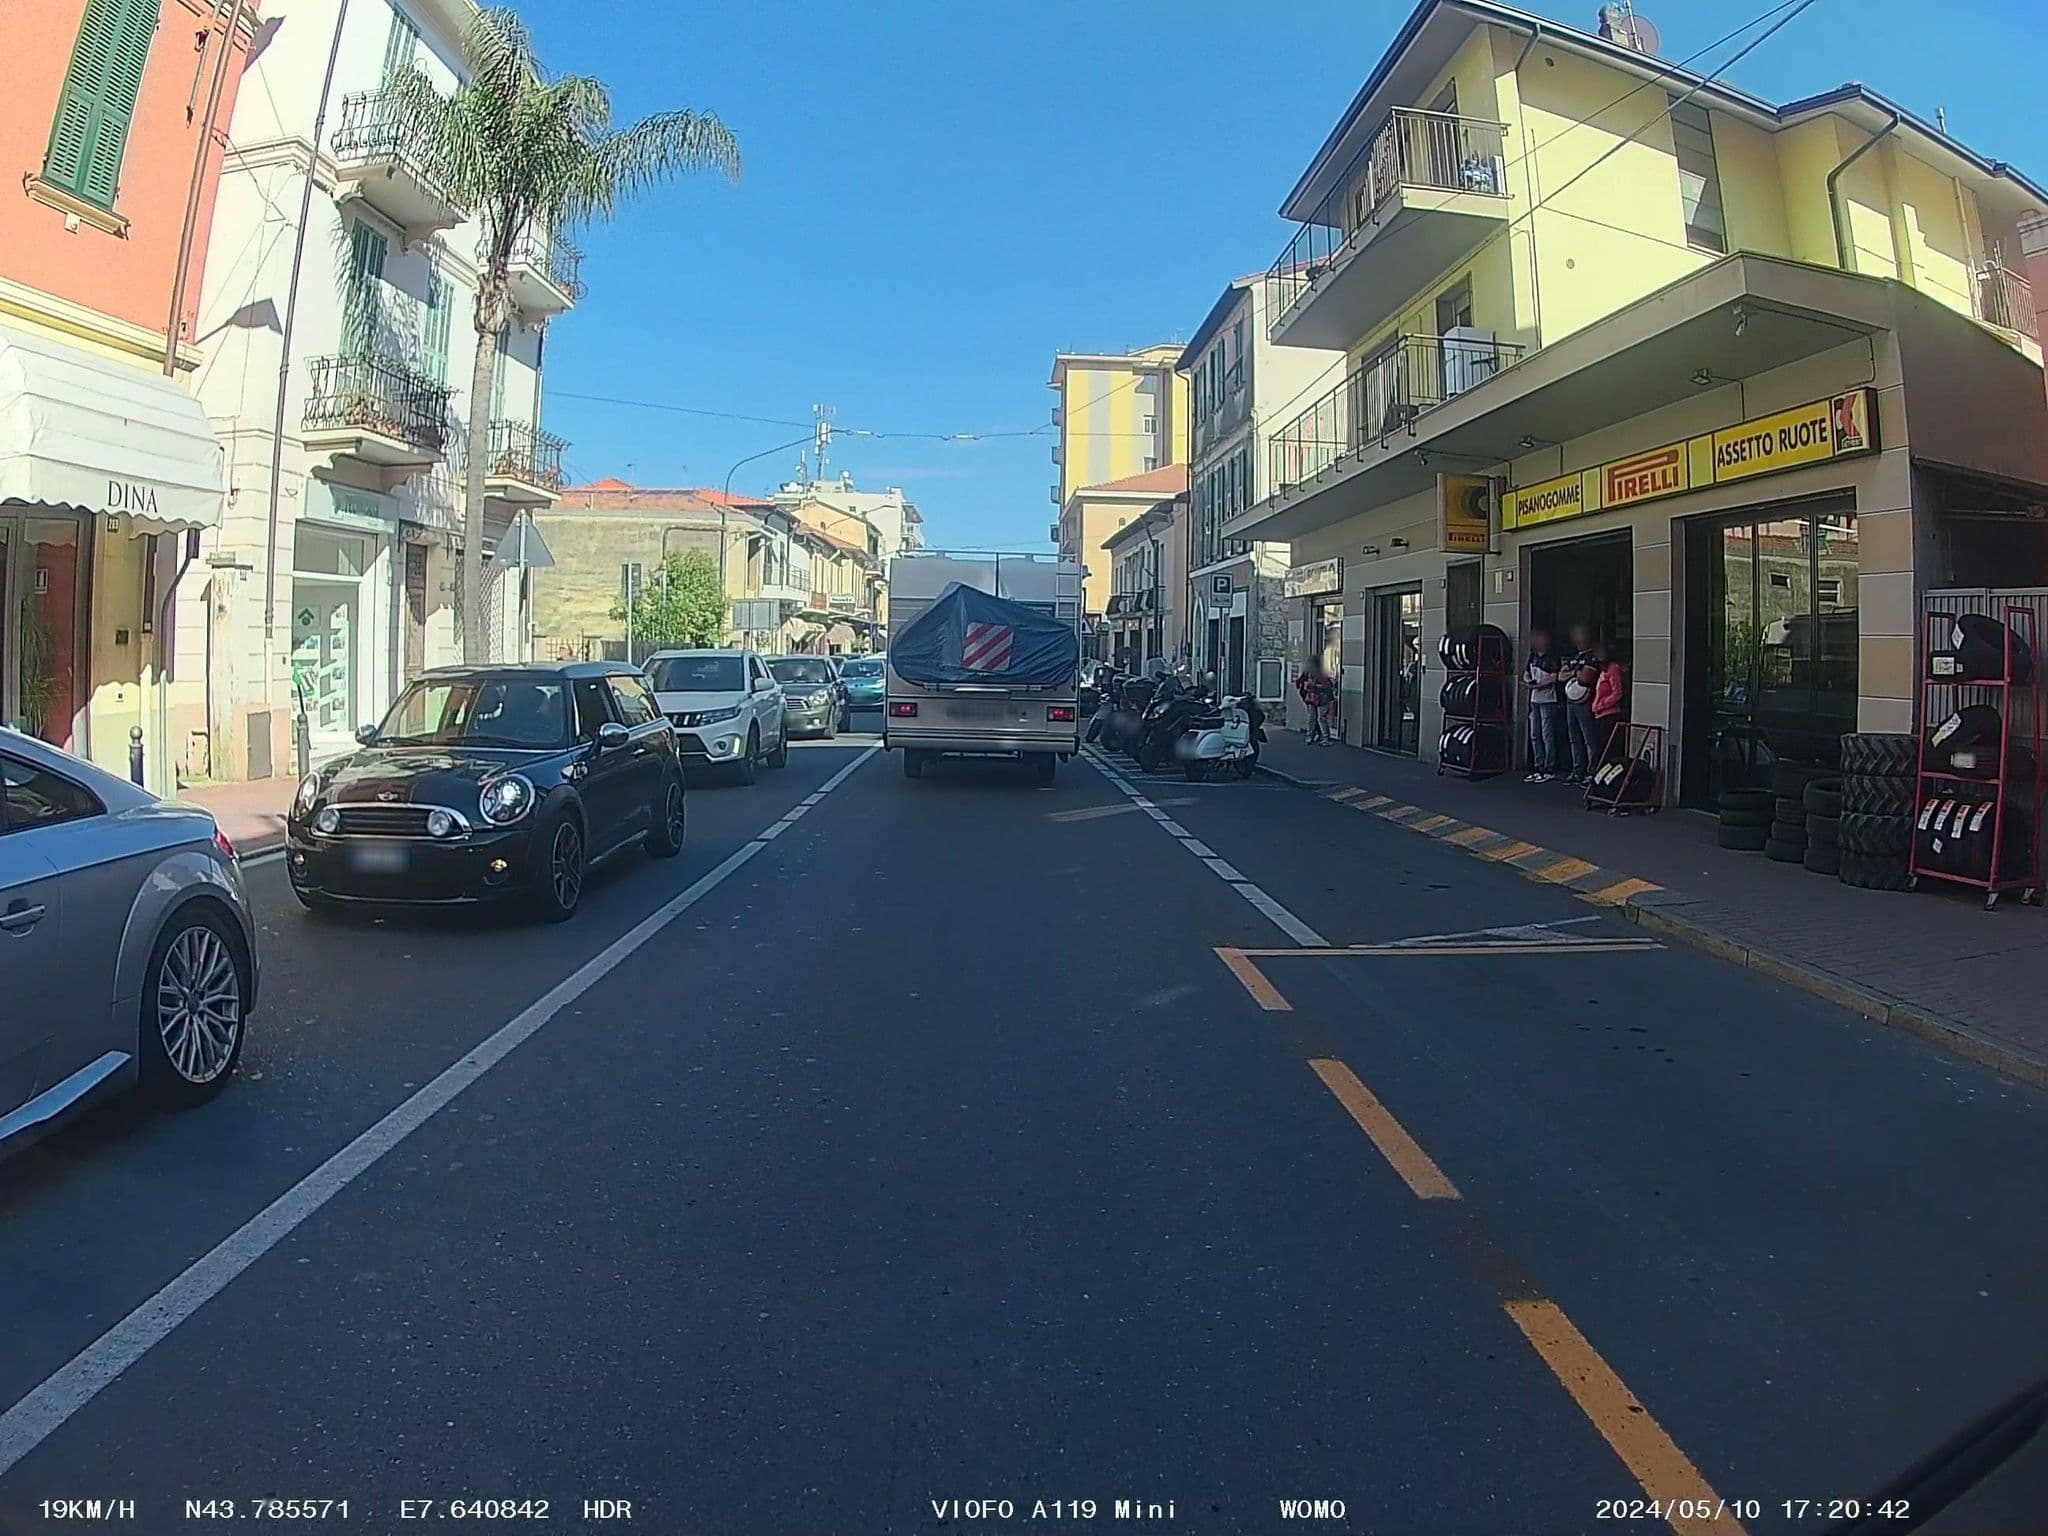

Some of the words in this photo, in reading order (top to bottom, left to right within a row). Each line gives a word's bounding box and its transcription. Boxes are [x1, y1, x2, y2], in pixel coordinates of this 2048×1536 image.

[1717, 432, 1774, 468] ASSETTO
[1779, 417, 1828, 452] RUOTE
[1608, 449, 1680, 503] PIRELLI
[108, 480, 157, 513] DINA
[1518, 484, 1580, 516] PISANOGOMME
[1217, 579, 1228, 591] P
